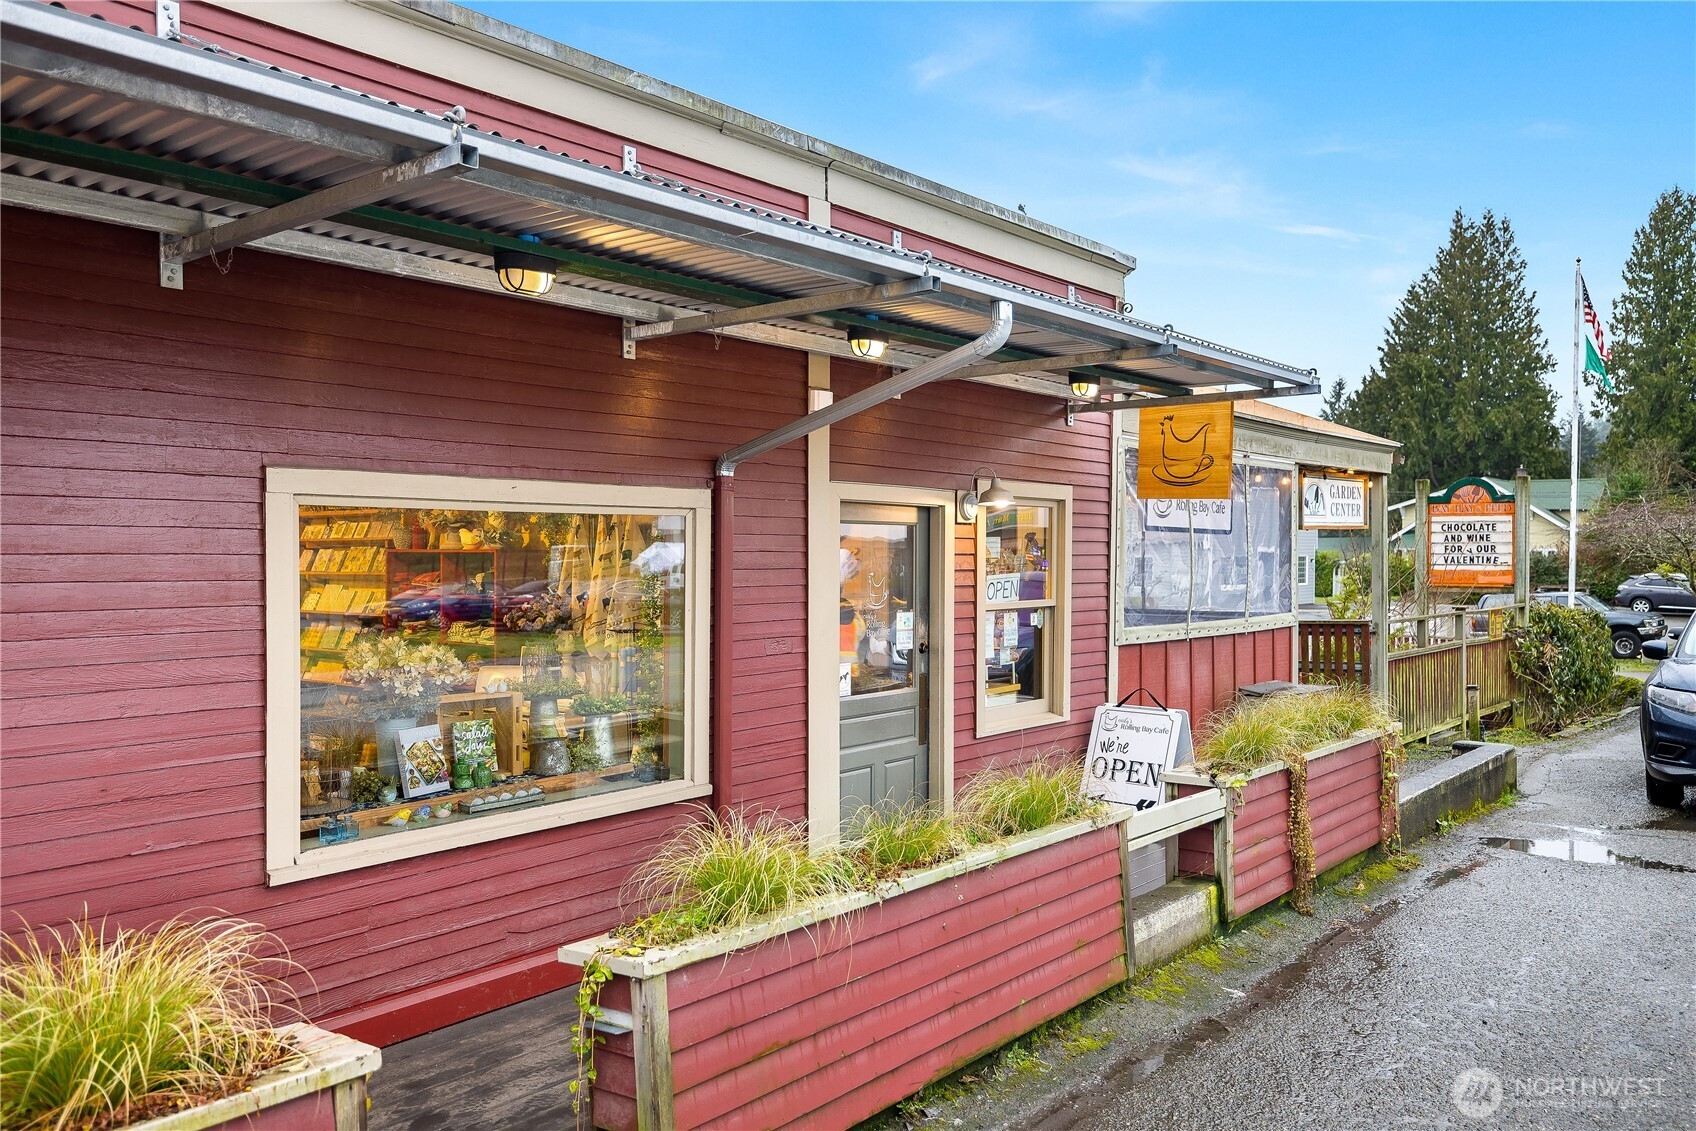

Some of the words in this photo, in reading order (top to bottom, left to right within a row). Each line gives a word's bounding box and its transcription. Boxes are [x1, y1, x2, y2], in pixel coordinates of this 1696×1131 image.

[1329, 484, 1362, 500] GARDEN
[1199, 500, 1210, 516] Bay
[1211, 501, 1226, 514] Cafe
[1330, 502, 1361, 517] CENTER
[1432, 504, 1450, 513] BAY
[1454, 504, 1473, 513] HAY
[1441, 523, 1497, 532] CHOCOLATE
[1444, 534, 1463, 543] AND
[1466, 533, 1491, 542] WINE
[1444, 544, 1463, 553] FOR
[986, 580, 1019, 601] OPEN
[461, 724, 491, 740] salad
[1120, 723, 1141, 733] Rolling
[1141, 725, 1154, 735] Bay
[1153, 726, 1170, 735] Cafe
[1099, 736, 1130, 754] We're
[1091, 756, 1163, 788] OPEN
